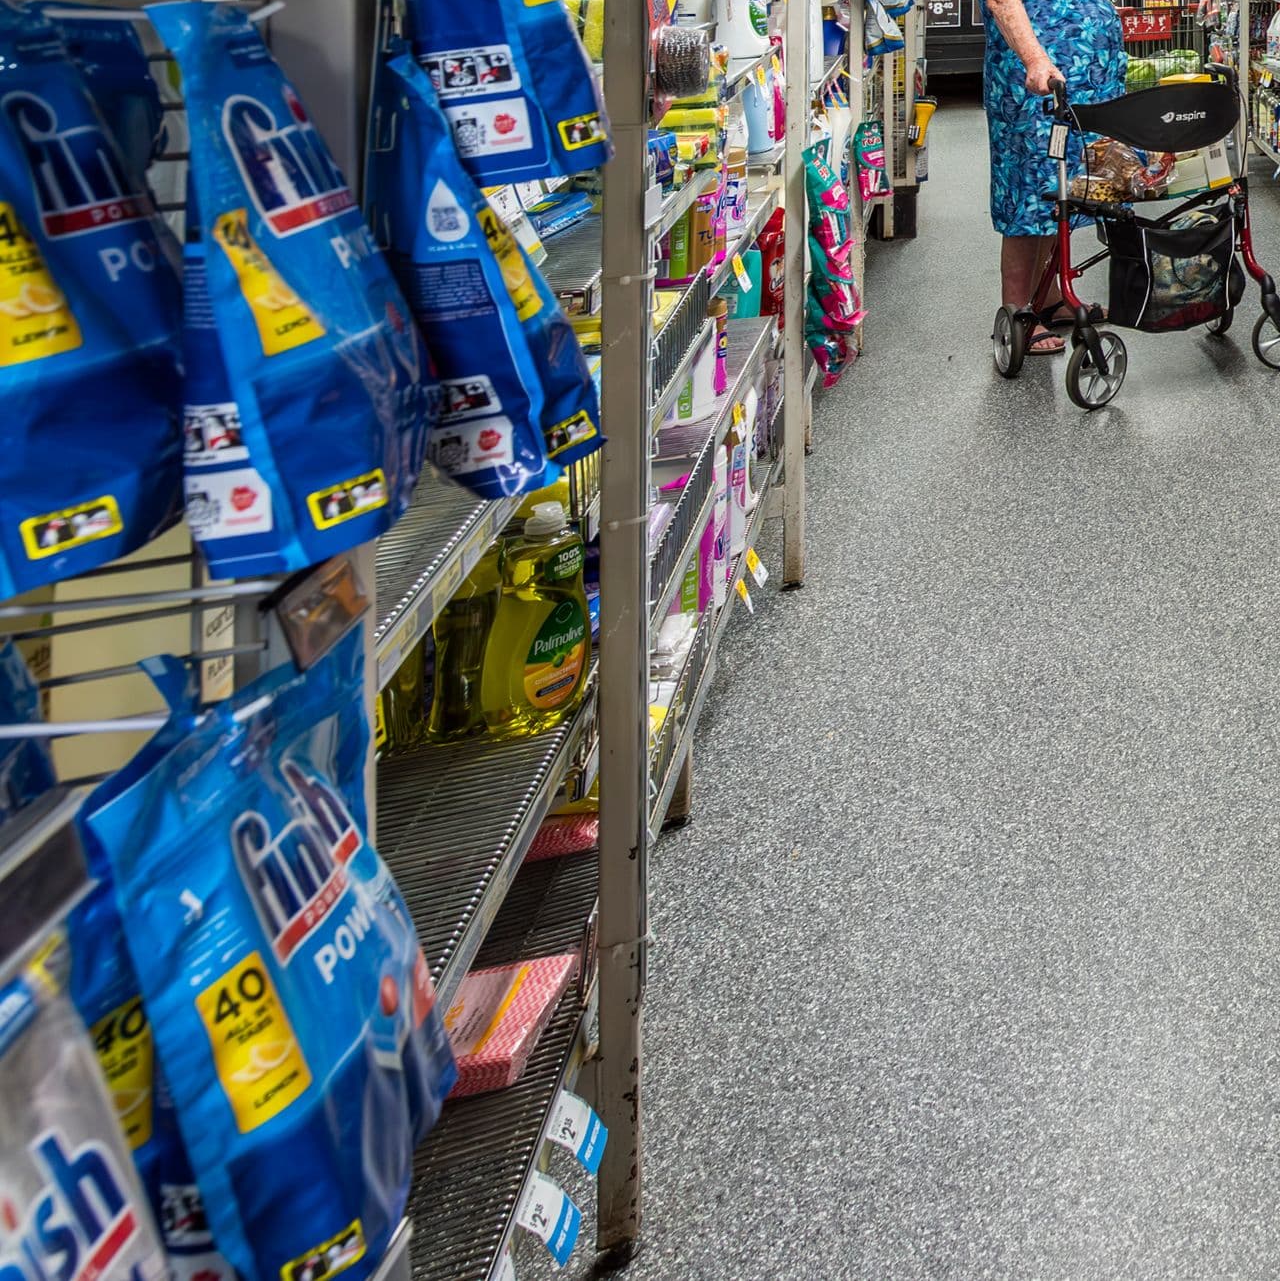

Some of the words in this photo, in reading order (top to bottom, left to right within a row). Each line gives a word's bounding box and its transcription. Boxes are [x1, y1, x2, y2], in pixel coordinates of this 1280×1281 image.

[1176, 111, 1206, 122] aspire
[559, 547, 580, 562] 100%
[534, 626, 584, 656] Palmolive
[213, 967, 266, 1026] 40
